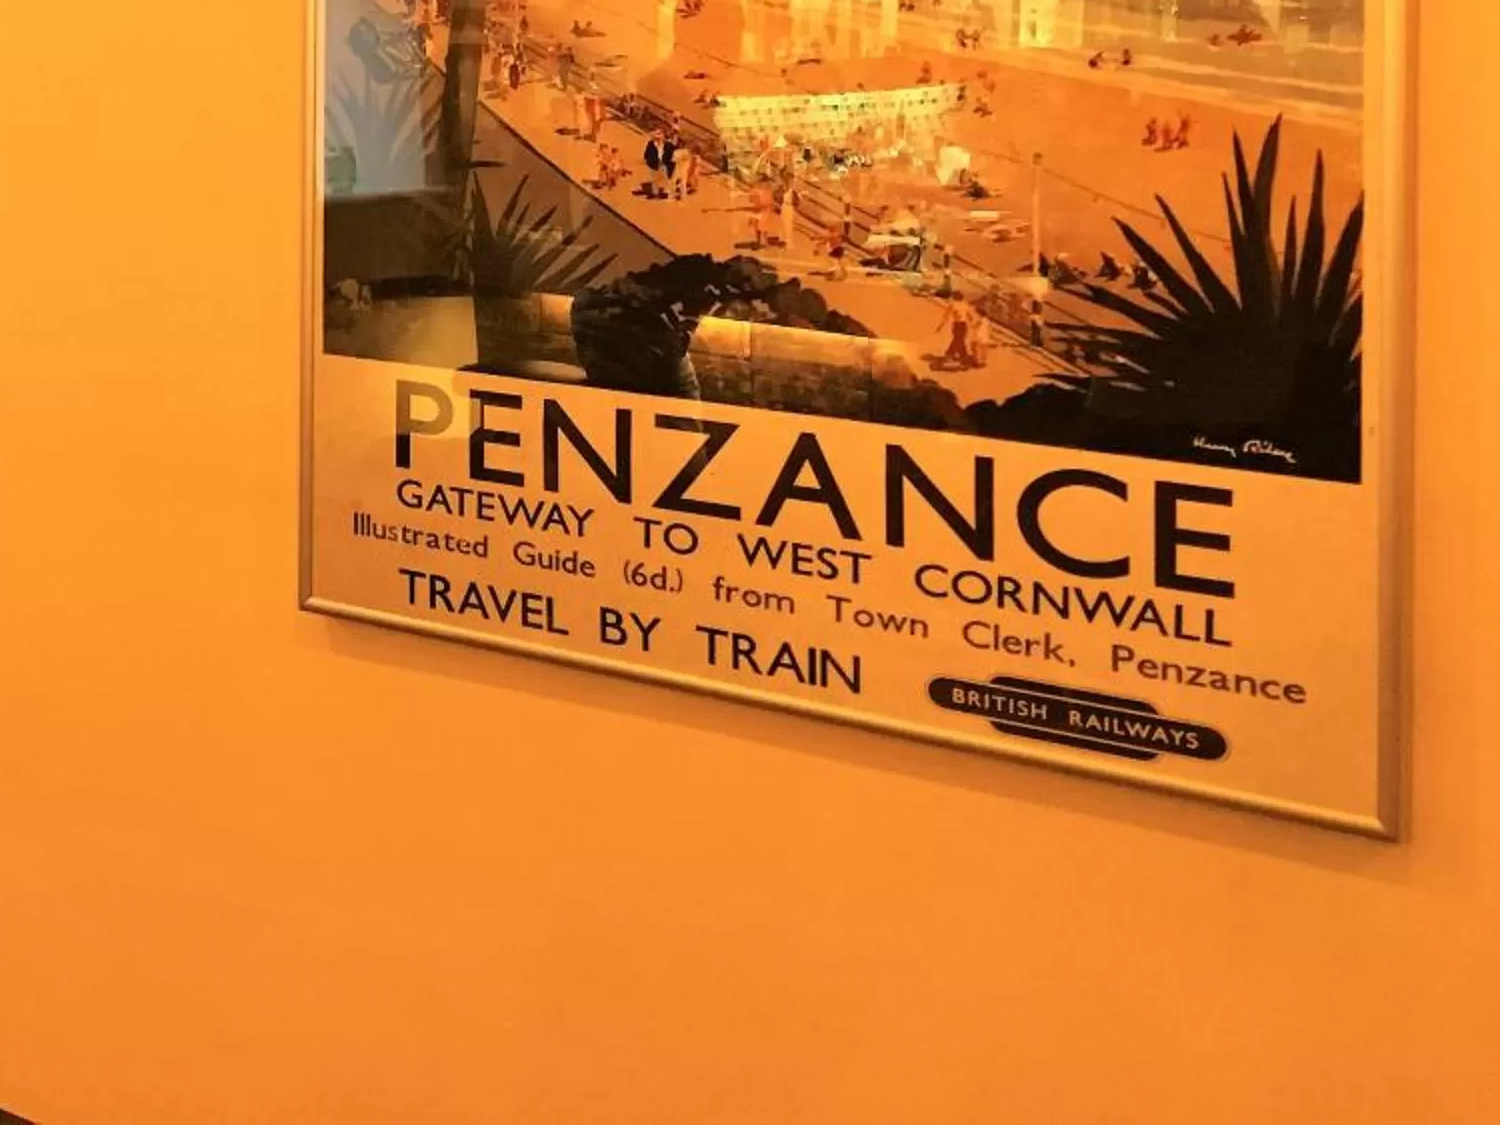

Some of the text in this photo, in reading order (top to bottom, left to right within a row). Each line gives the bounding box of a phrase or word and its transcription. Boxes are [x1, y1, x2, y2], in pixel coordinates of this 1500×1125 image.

[395, 379, 1235, 599] PENZANCE
[397, 479, 1232, 647] GATEWAY TO WEST CORNWALL
[353, 511, 1307, 704] Illustrated Guide (6d.) from Town Clerk, Penzance
[398, 568, 861, 694] TRAVEL BY TRAIN
[952, 687, 1199, 750] BRITISH RAILWAYS
